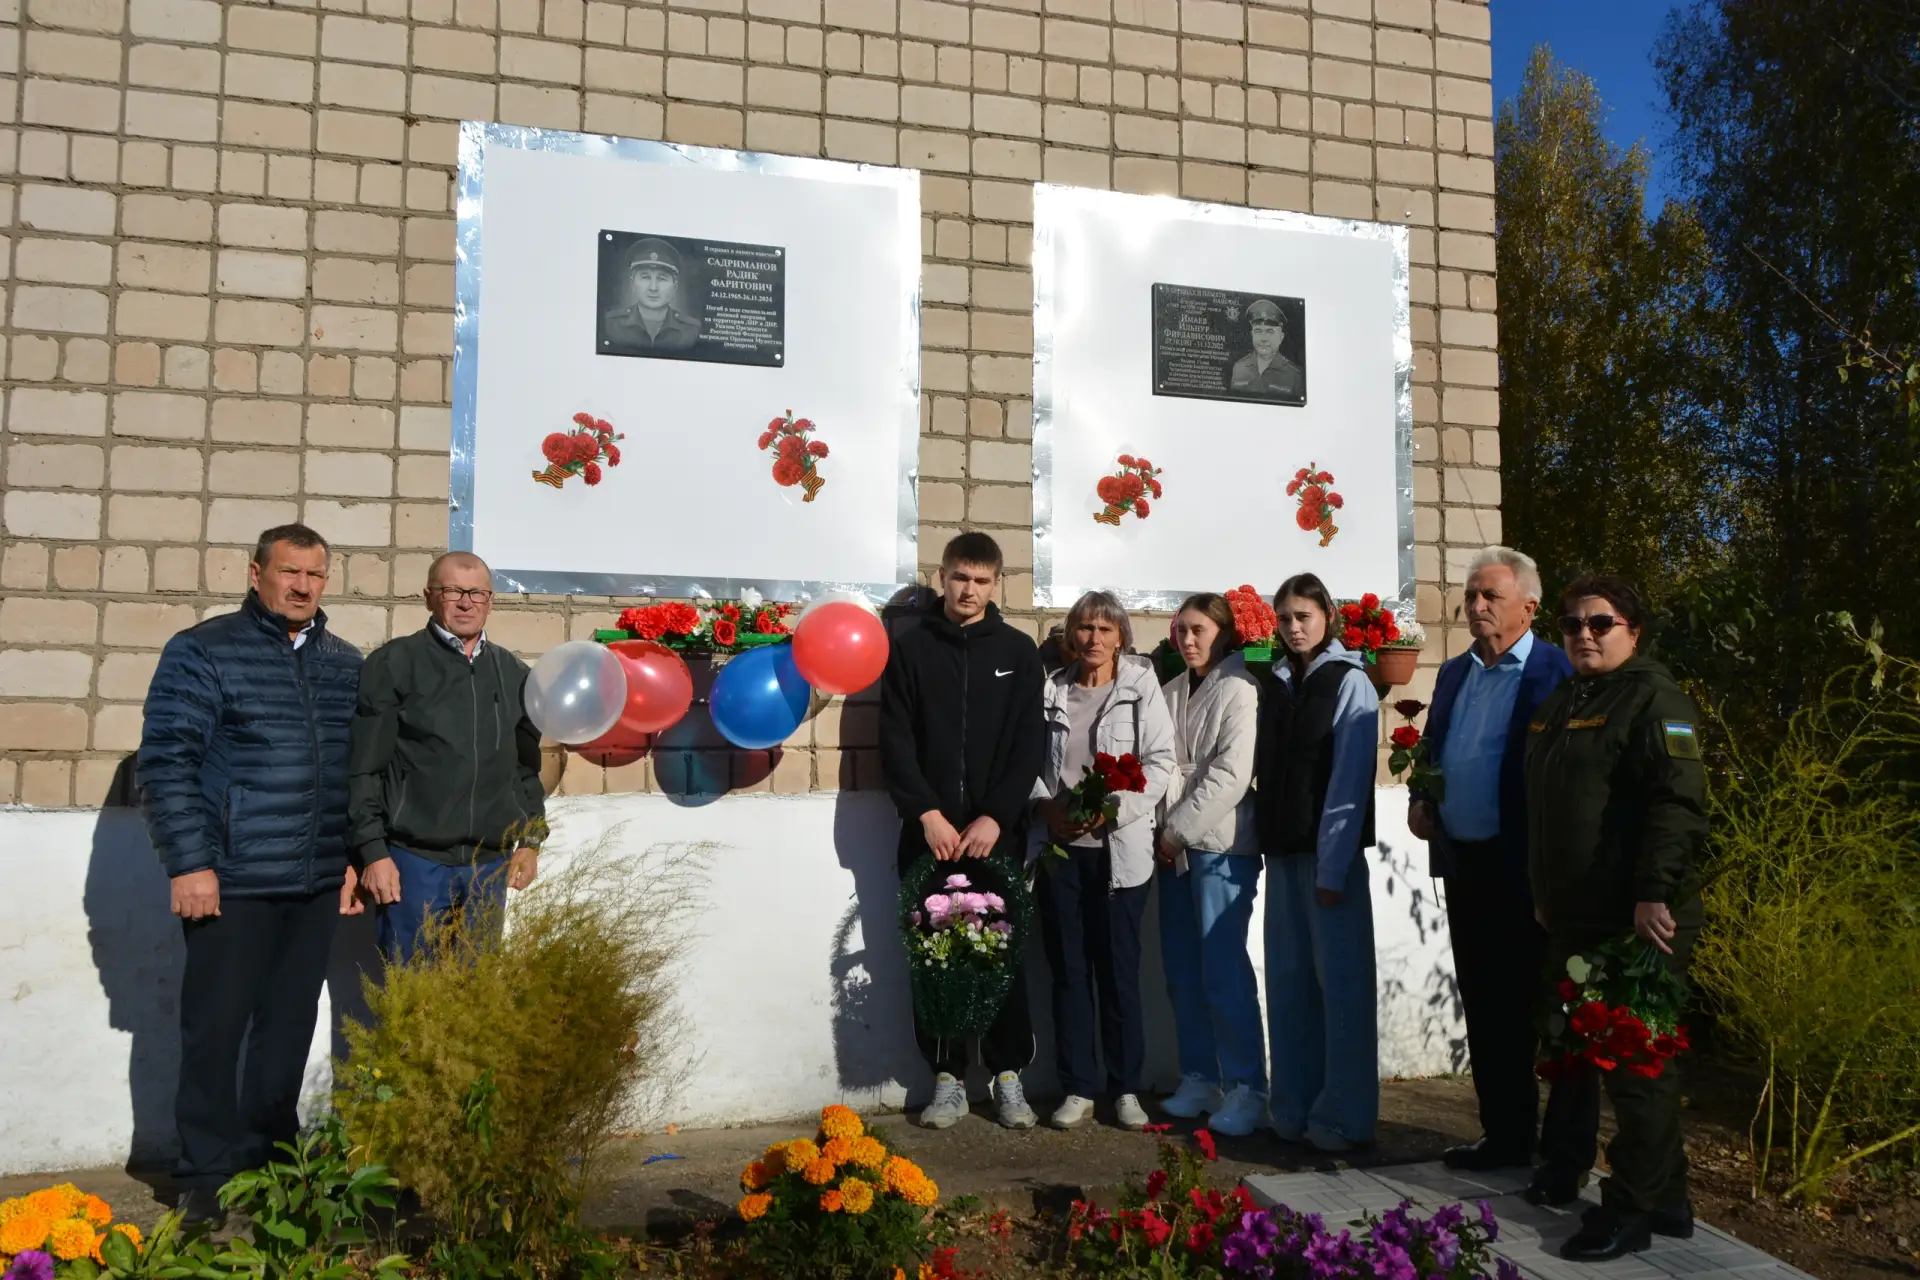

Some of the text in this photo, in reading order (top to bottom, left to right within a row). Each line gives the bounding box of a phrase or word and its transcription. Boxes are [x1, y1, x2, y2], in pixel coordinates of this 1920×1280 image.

[707, 257, 777, 271] САДРИМАНОВ
[726, 269, 759, 280] РАДИК
[710, 279, 773, 292] ФАРИТОВИЧ
